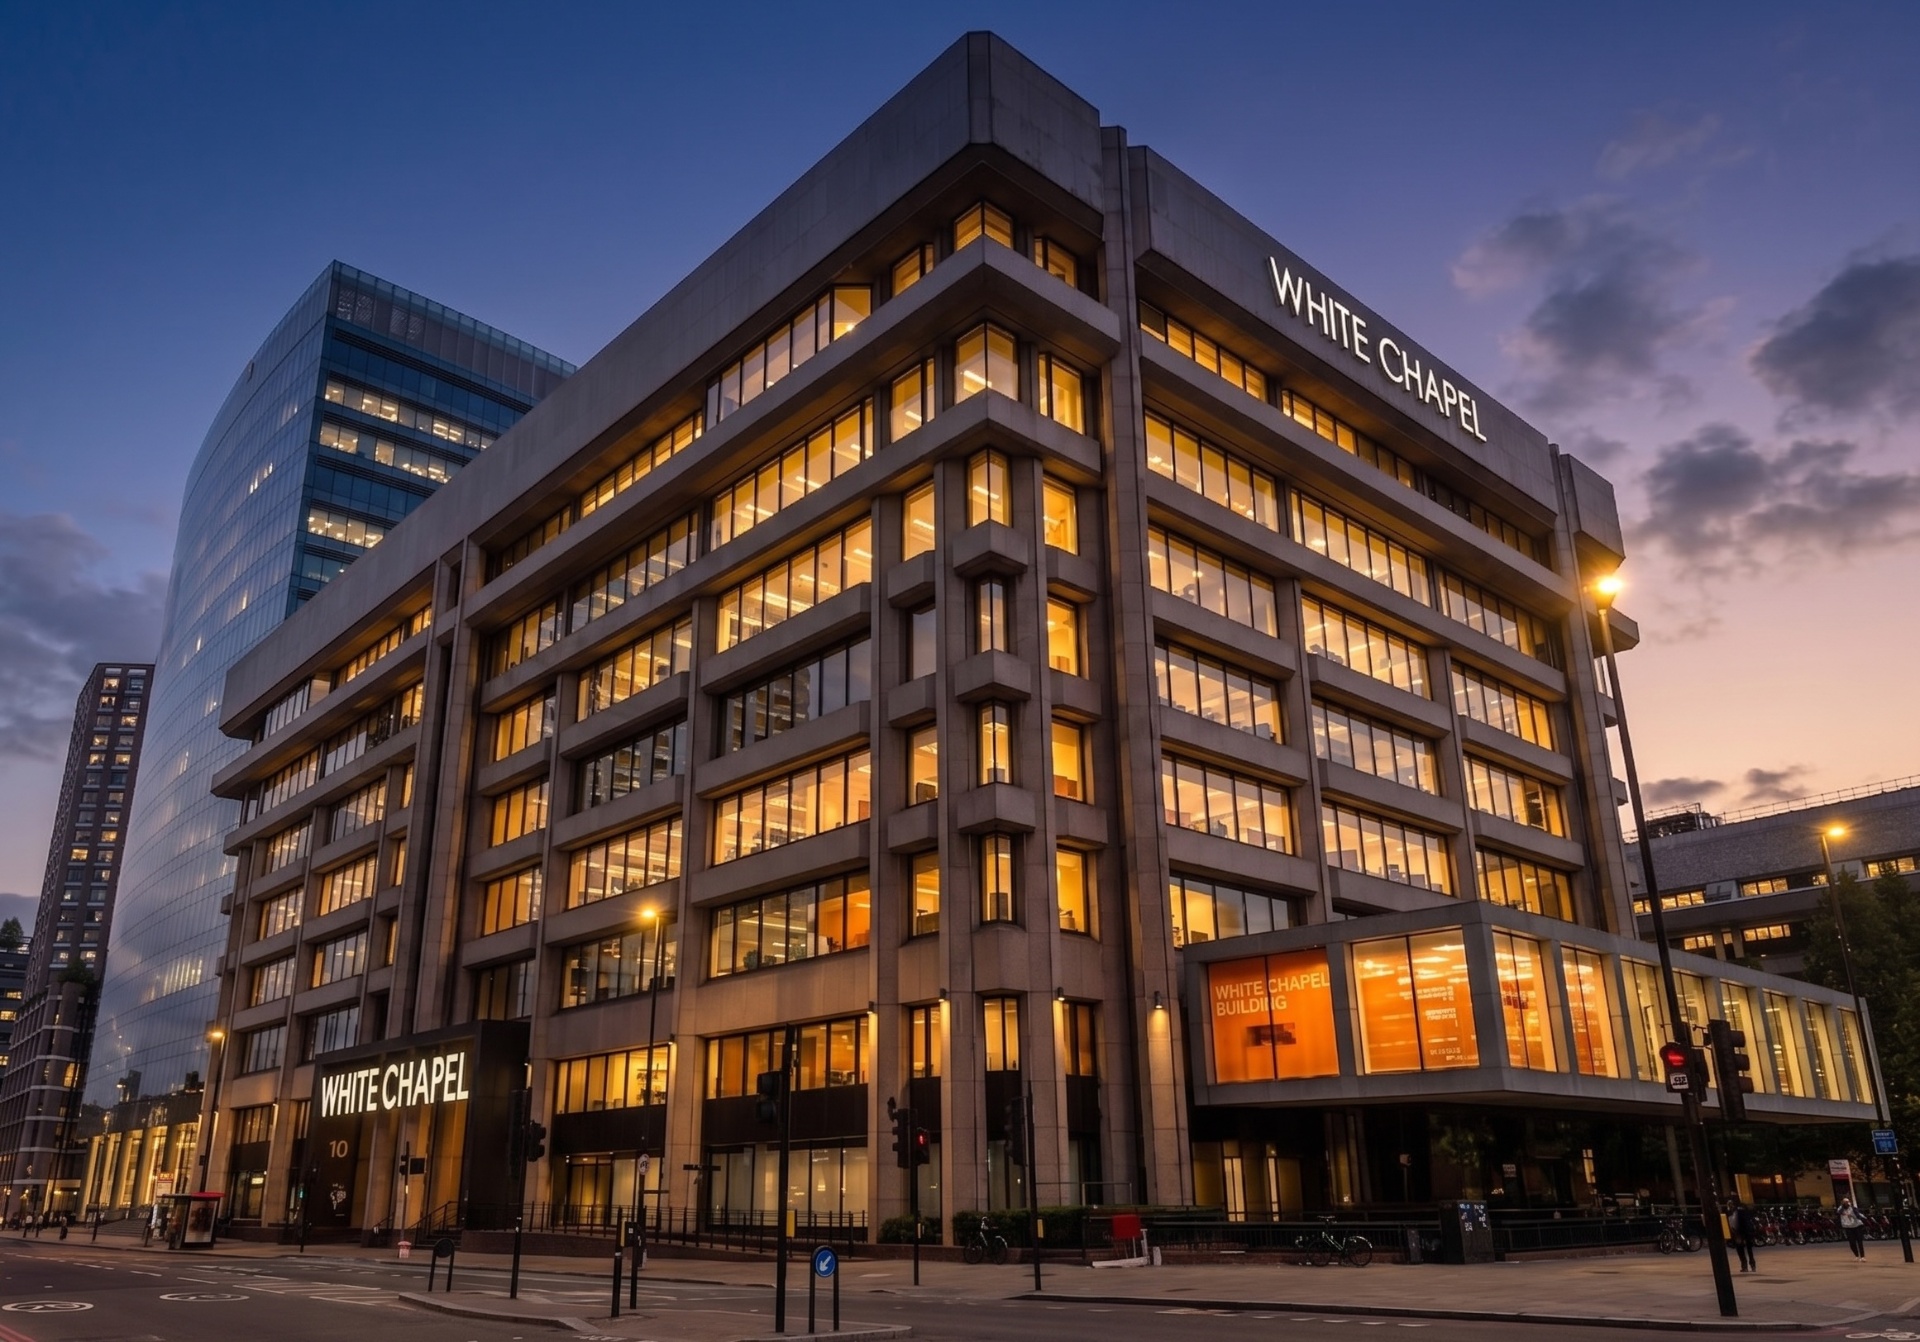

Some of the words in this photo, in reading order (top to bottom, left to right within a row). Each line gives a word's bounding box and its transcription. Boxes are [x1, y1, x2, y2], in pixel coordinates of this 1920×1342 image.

[1269, 256, 1371, 363] WHITE
[1379, 337, 1487, 442] CHAPEL
[1215, 981, 1264, 1000] WHITE
[1268, 972, 1330, 993] CHAPEL
[1216, 996, 1287, 1016] BUILDING
[321, 1067, 380, 1117] WHITE
[382, 1052, 469, 1110] CHAPEL
[329, 1140, 348, 1158] 10
